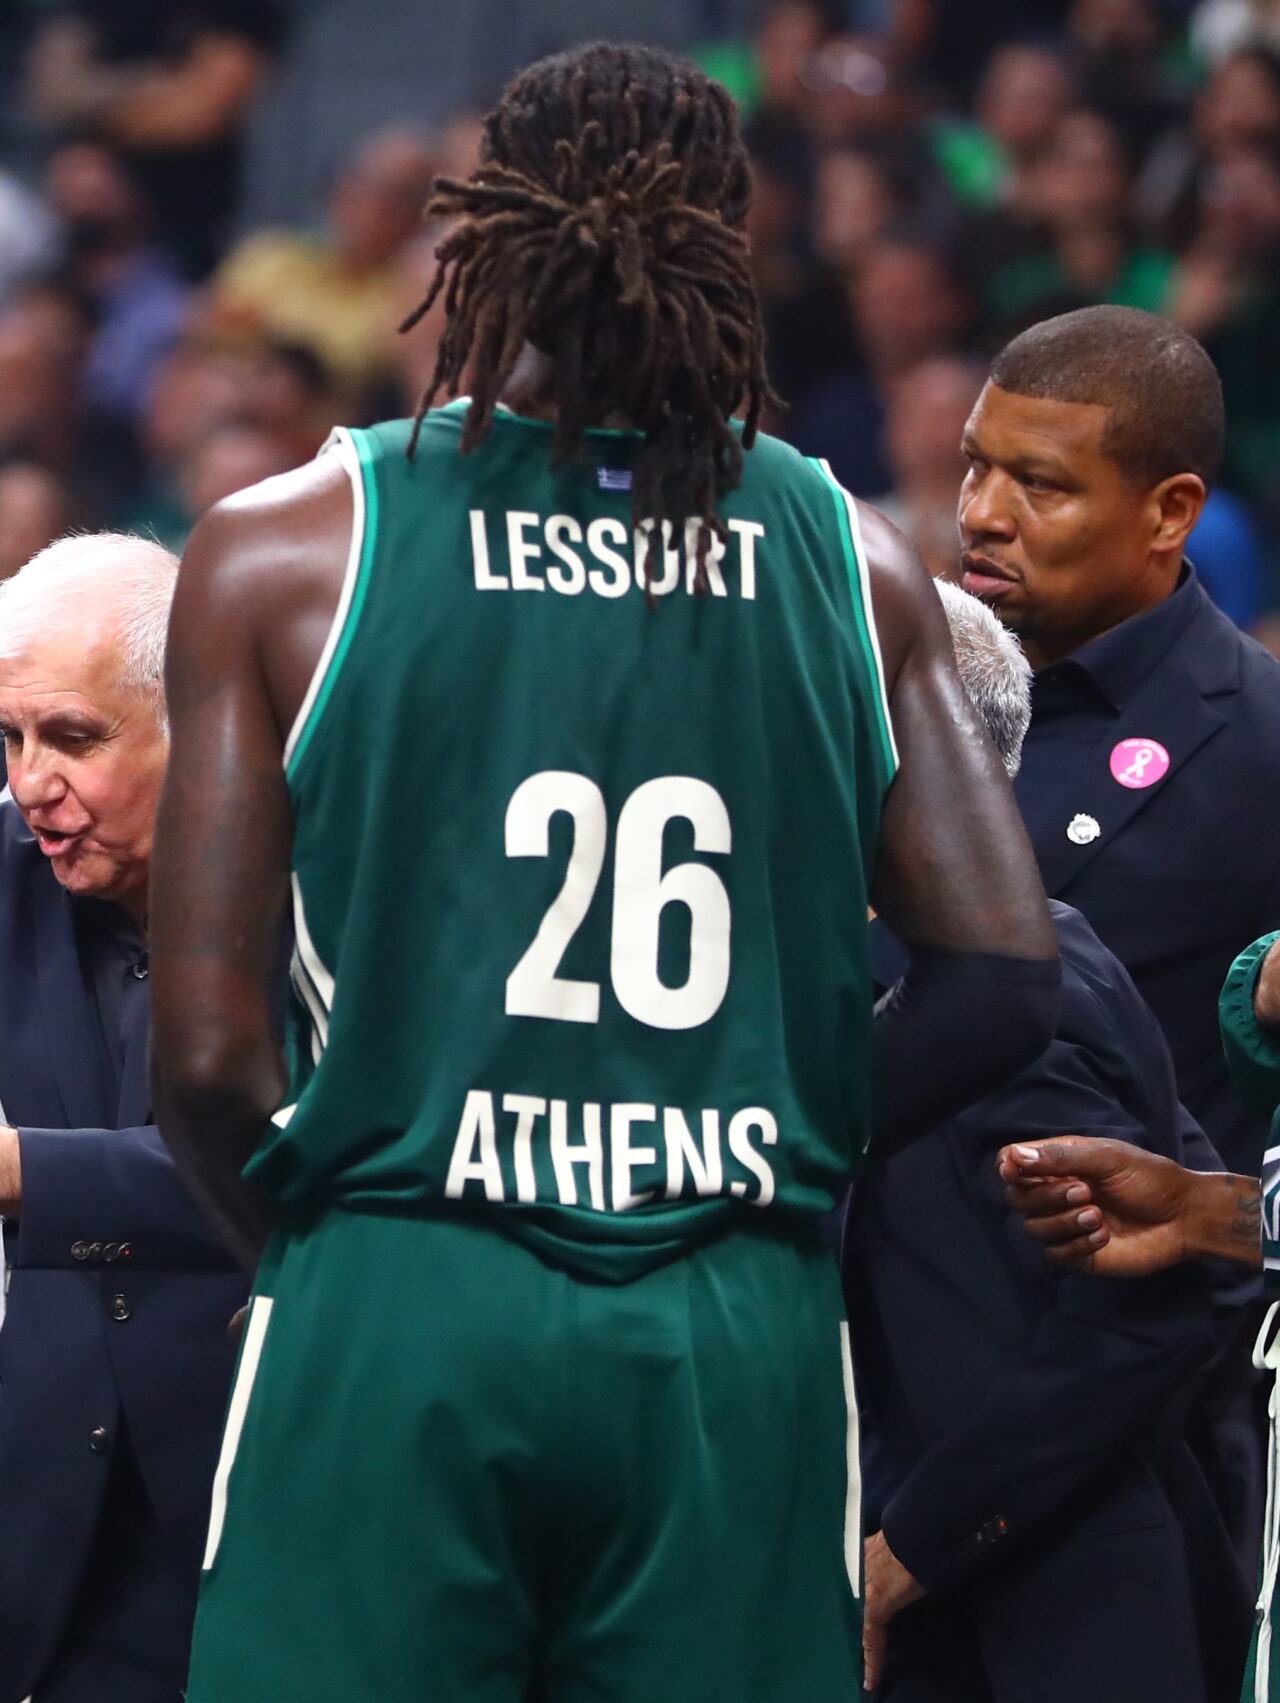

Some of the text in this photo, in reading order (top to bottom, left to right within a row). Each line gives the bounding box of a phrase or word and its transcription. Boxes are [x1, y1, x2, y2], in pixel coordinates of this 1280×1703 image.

[469, 509, 765, 600] LESSORT
[504, 770, 732, 1030] 26
[444, 1089, 778, 1212] ATHENS
